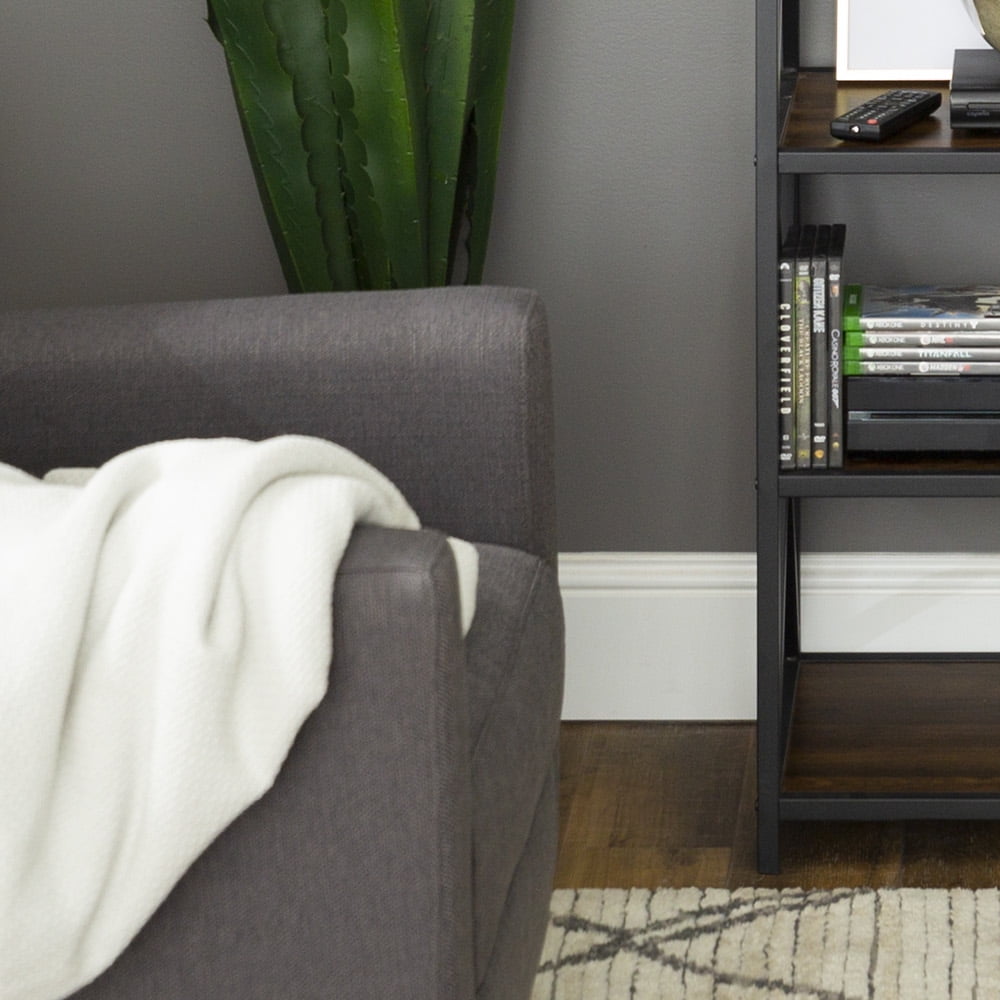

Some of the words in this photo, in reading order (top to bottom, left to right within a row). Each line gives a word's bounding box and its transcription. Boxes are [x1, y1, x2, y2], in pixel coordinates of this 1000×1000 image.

[813, 278, 825, 309] CITIZEN
[813, 310, 825, 333] KANE
[780, 303, 791, 415] CLOVERFIELD
[830, 328, 840, 360] CASINO
[919, 350, 972, 358] TITANFALL
